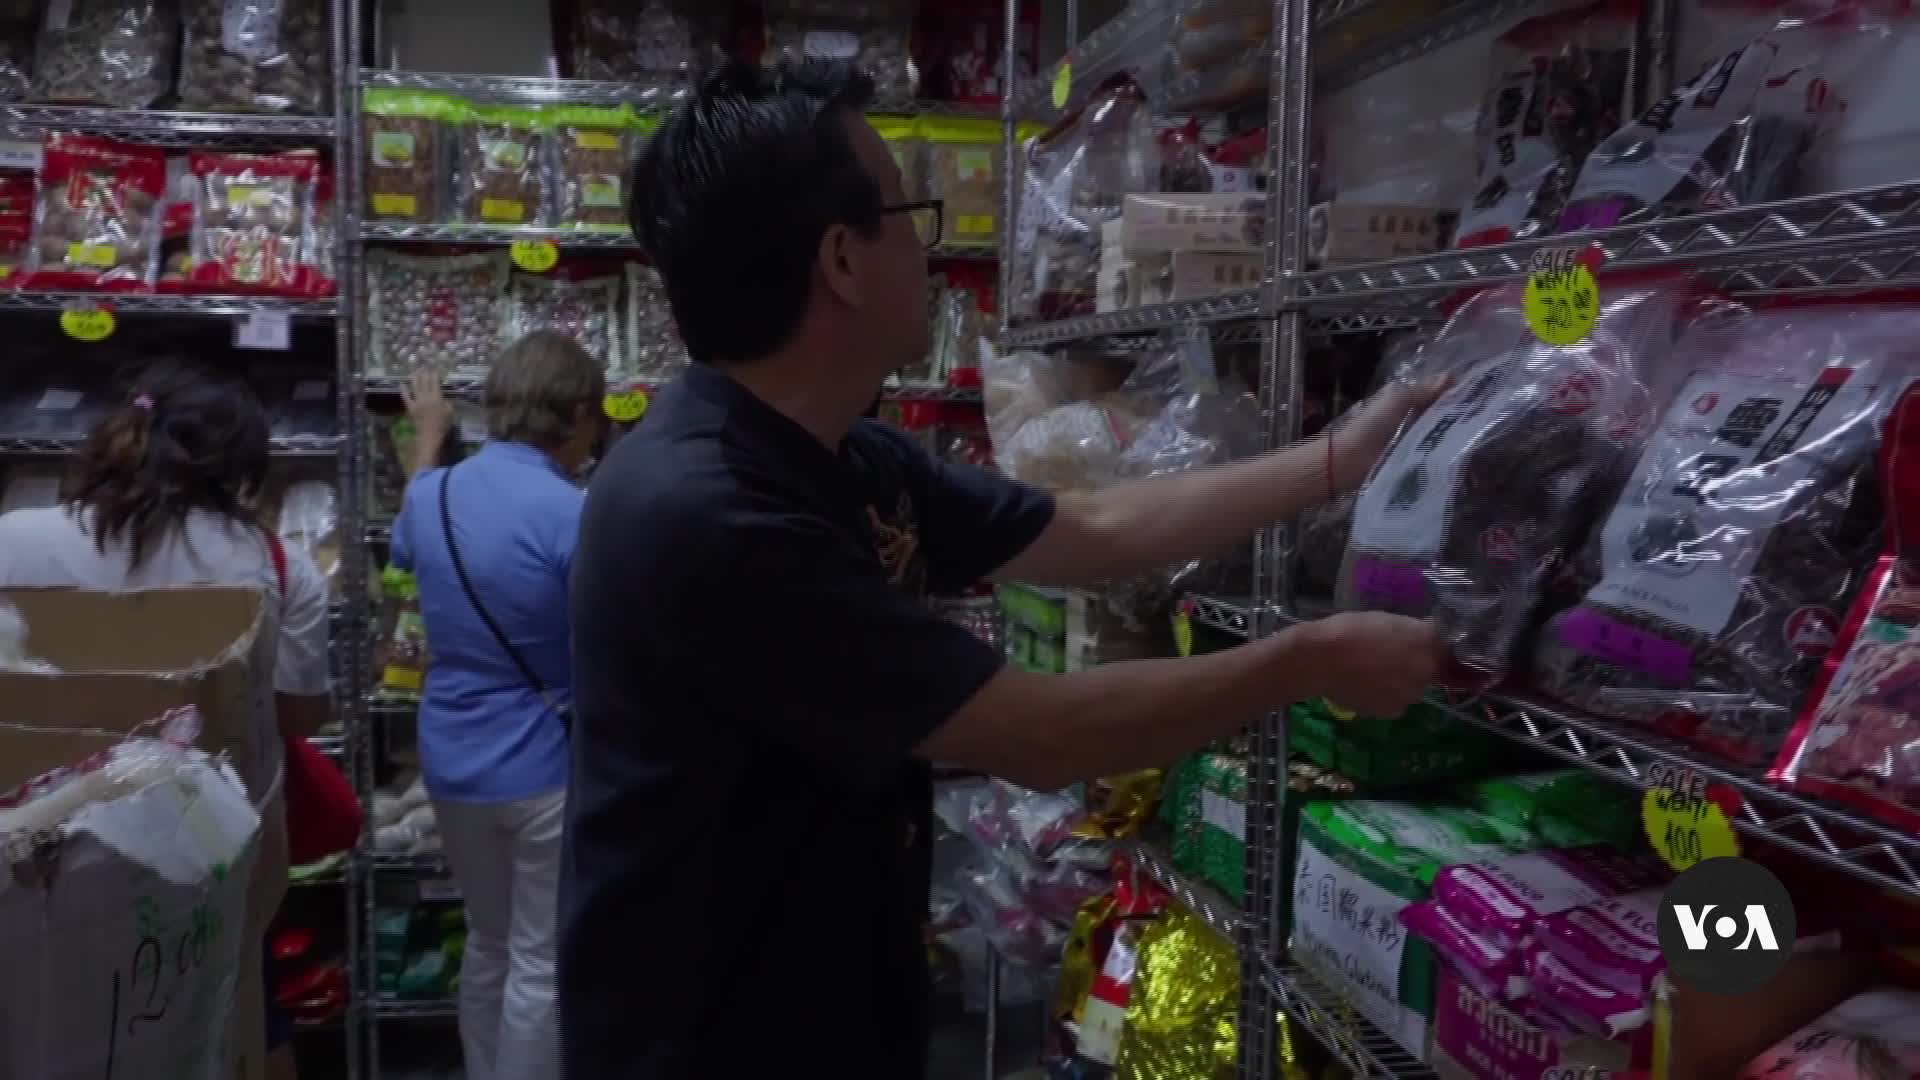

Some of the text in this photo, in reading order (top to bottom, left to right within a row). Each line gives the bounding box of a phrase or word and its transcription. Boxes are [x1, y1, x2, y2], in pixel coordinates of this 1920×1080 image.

[1532, 248, 1577, 271] SALE
[1648, 762, 1706, 799] SALE
[1664, 820, 1701, 862] 100
